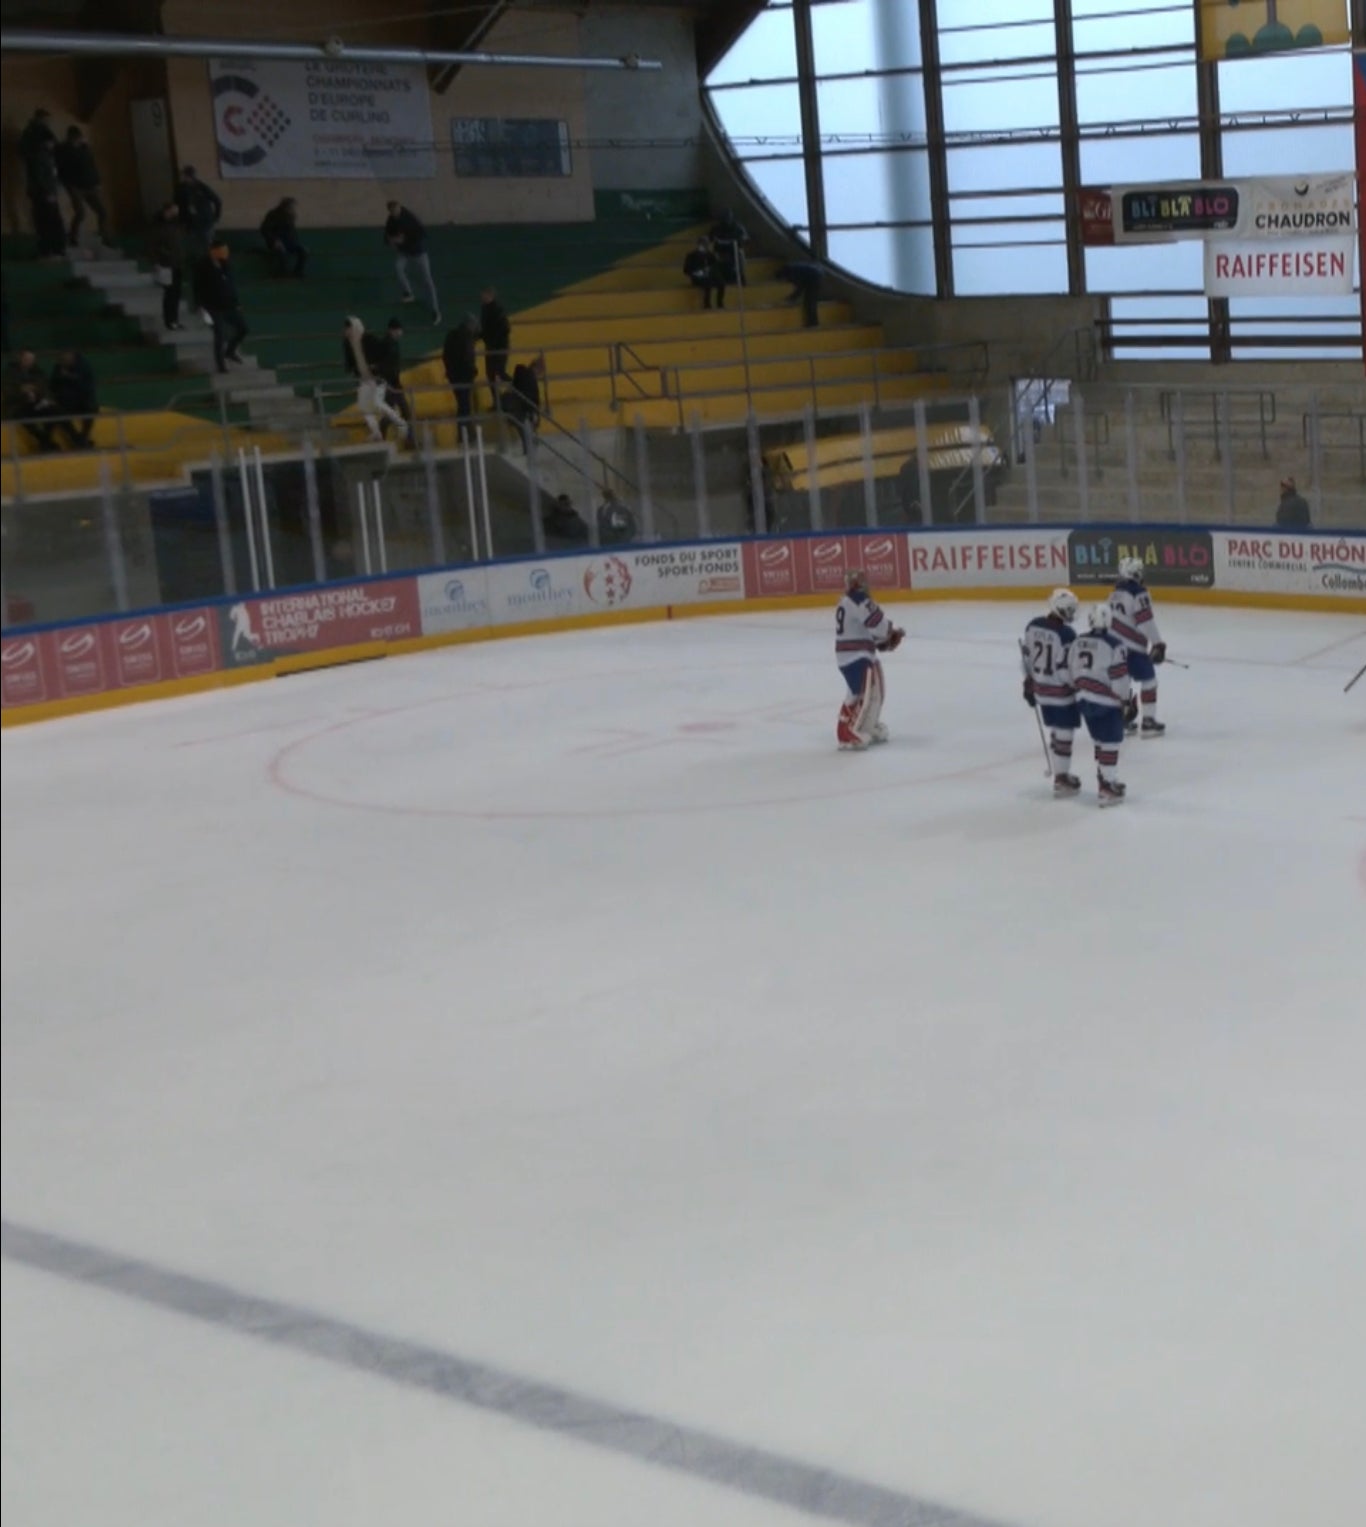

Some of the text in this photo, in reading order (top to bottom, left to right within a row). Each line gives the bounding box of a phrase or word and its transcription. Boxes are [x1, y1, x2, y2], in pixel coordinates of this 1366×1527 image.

[1255, 211, 1351, 229] CHAUDRON
[1216, 252, 1345, 279] RAIFFEISEN
[635, 549, 738, 566] FONDS DU SPORT
[912, 544, 1067, 572] RAIFFEISEN
[1228, 539, 1273, 559] PARC
[1279, 541, 1304, 559] DU
[658, 562, 739, 578] SPORT-FONDS
[1033, 640, 1053, 676] 21
